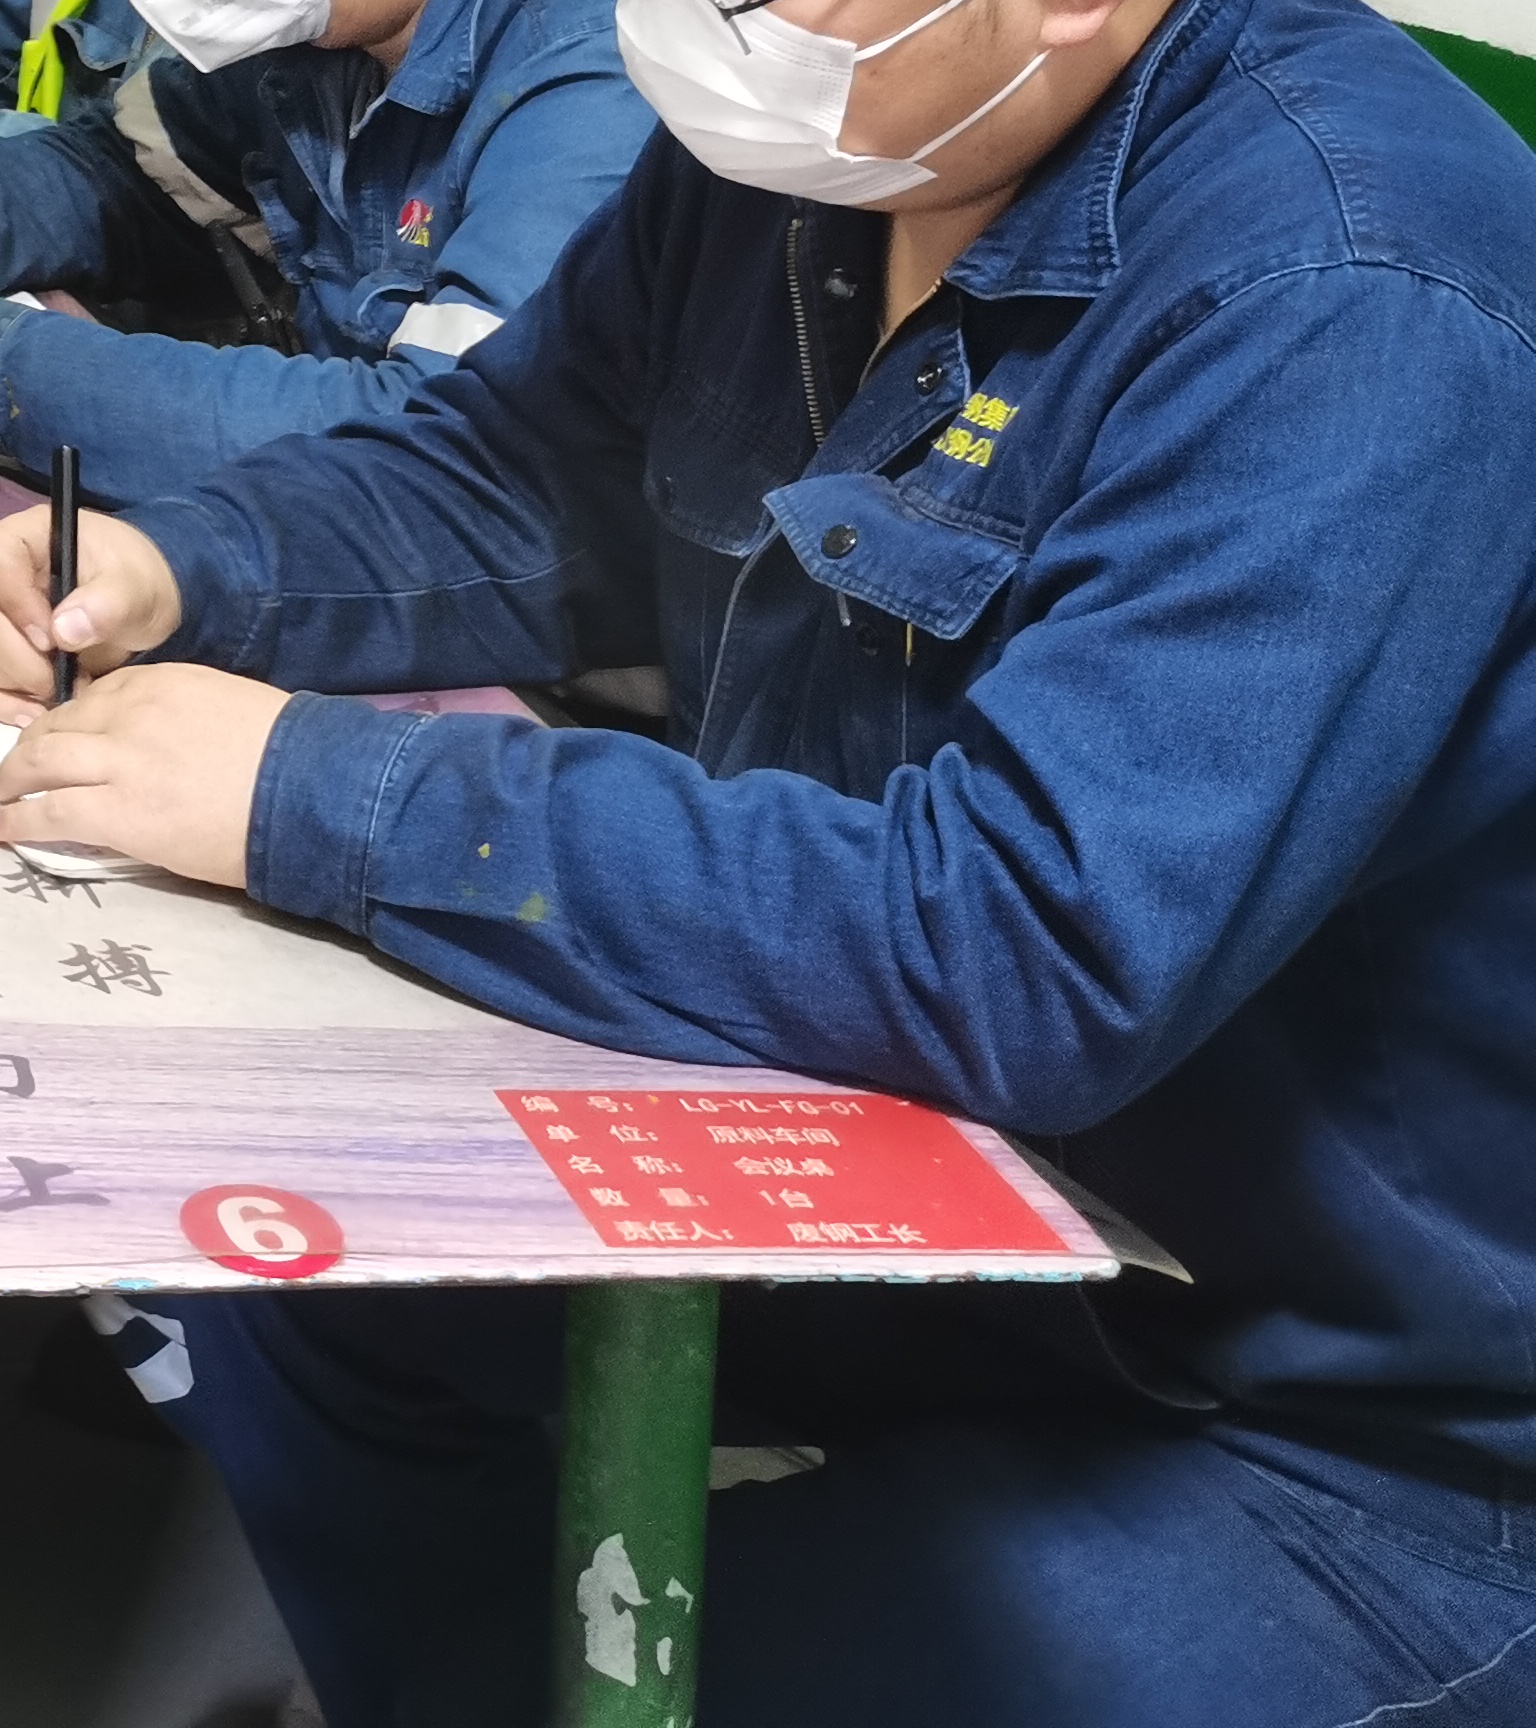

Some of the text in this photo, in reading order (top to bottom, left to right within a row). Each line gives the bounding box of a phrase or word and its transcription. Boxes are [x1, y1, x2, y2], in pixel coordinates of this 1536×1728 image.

[521, 1093, 560, 1115] 编
[547, 1124, 580, 1144] 单
[709, 1124, 840, 1148] 原料车间
[569, 1155, 606, 1175] 名
[732, 1155, 836, 1178] 会议桌
[589, 1187, 631, 1209] 数
[758, 1188, 816, 1211] 1台
[216, 1195, 309, 1263] 6
[786, 1221, 928, 1245] 废钢工长
